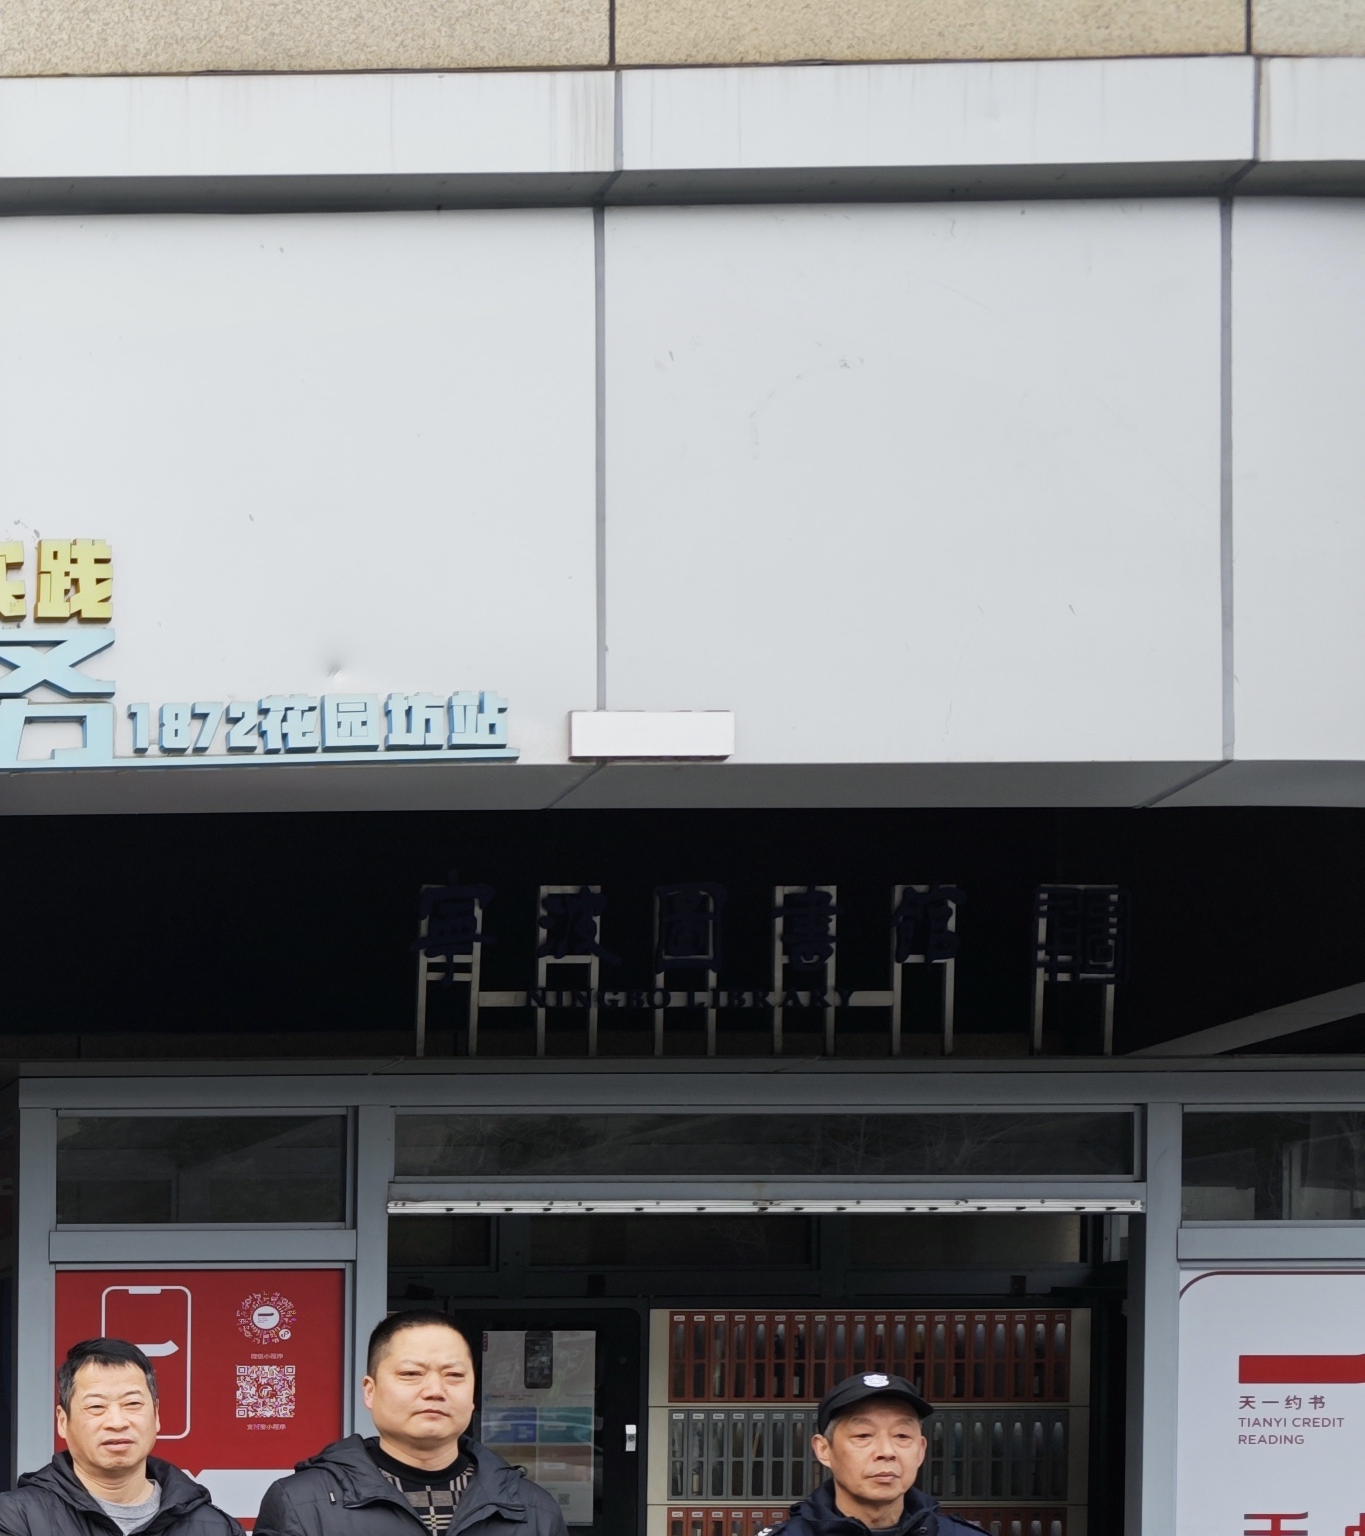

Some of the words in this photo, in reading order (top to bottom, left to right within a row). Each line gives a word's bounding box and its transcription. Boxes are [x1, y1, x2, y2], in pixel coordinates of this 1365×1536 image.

[127, 690, 509, 755] 1872花园坊站
[524, 986, 672, 1010] NINGBO
[686, 987, 856, 1010] LIBRARY
[1238, 1394, 1327, 1411] 天一约书
[1238, 1417, 1288, 1428] TIANYI
[1291, 1417, 1346, 1428] CREDIT
[1238, 1434, 1305, 1446] READING
